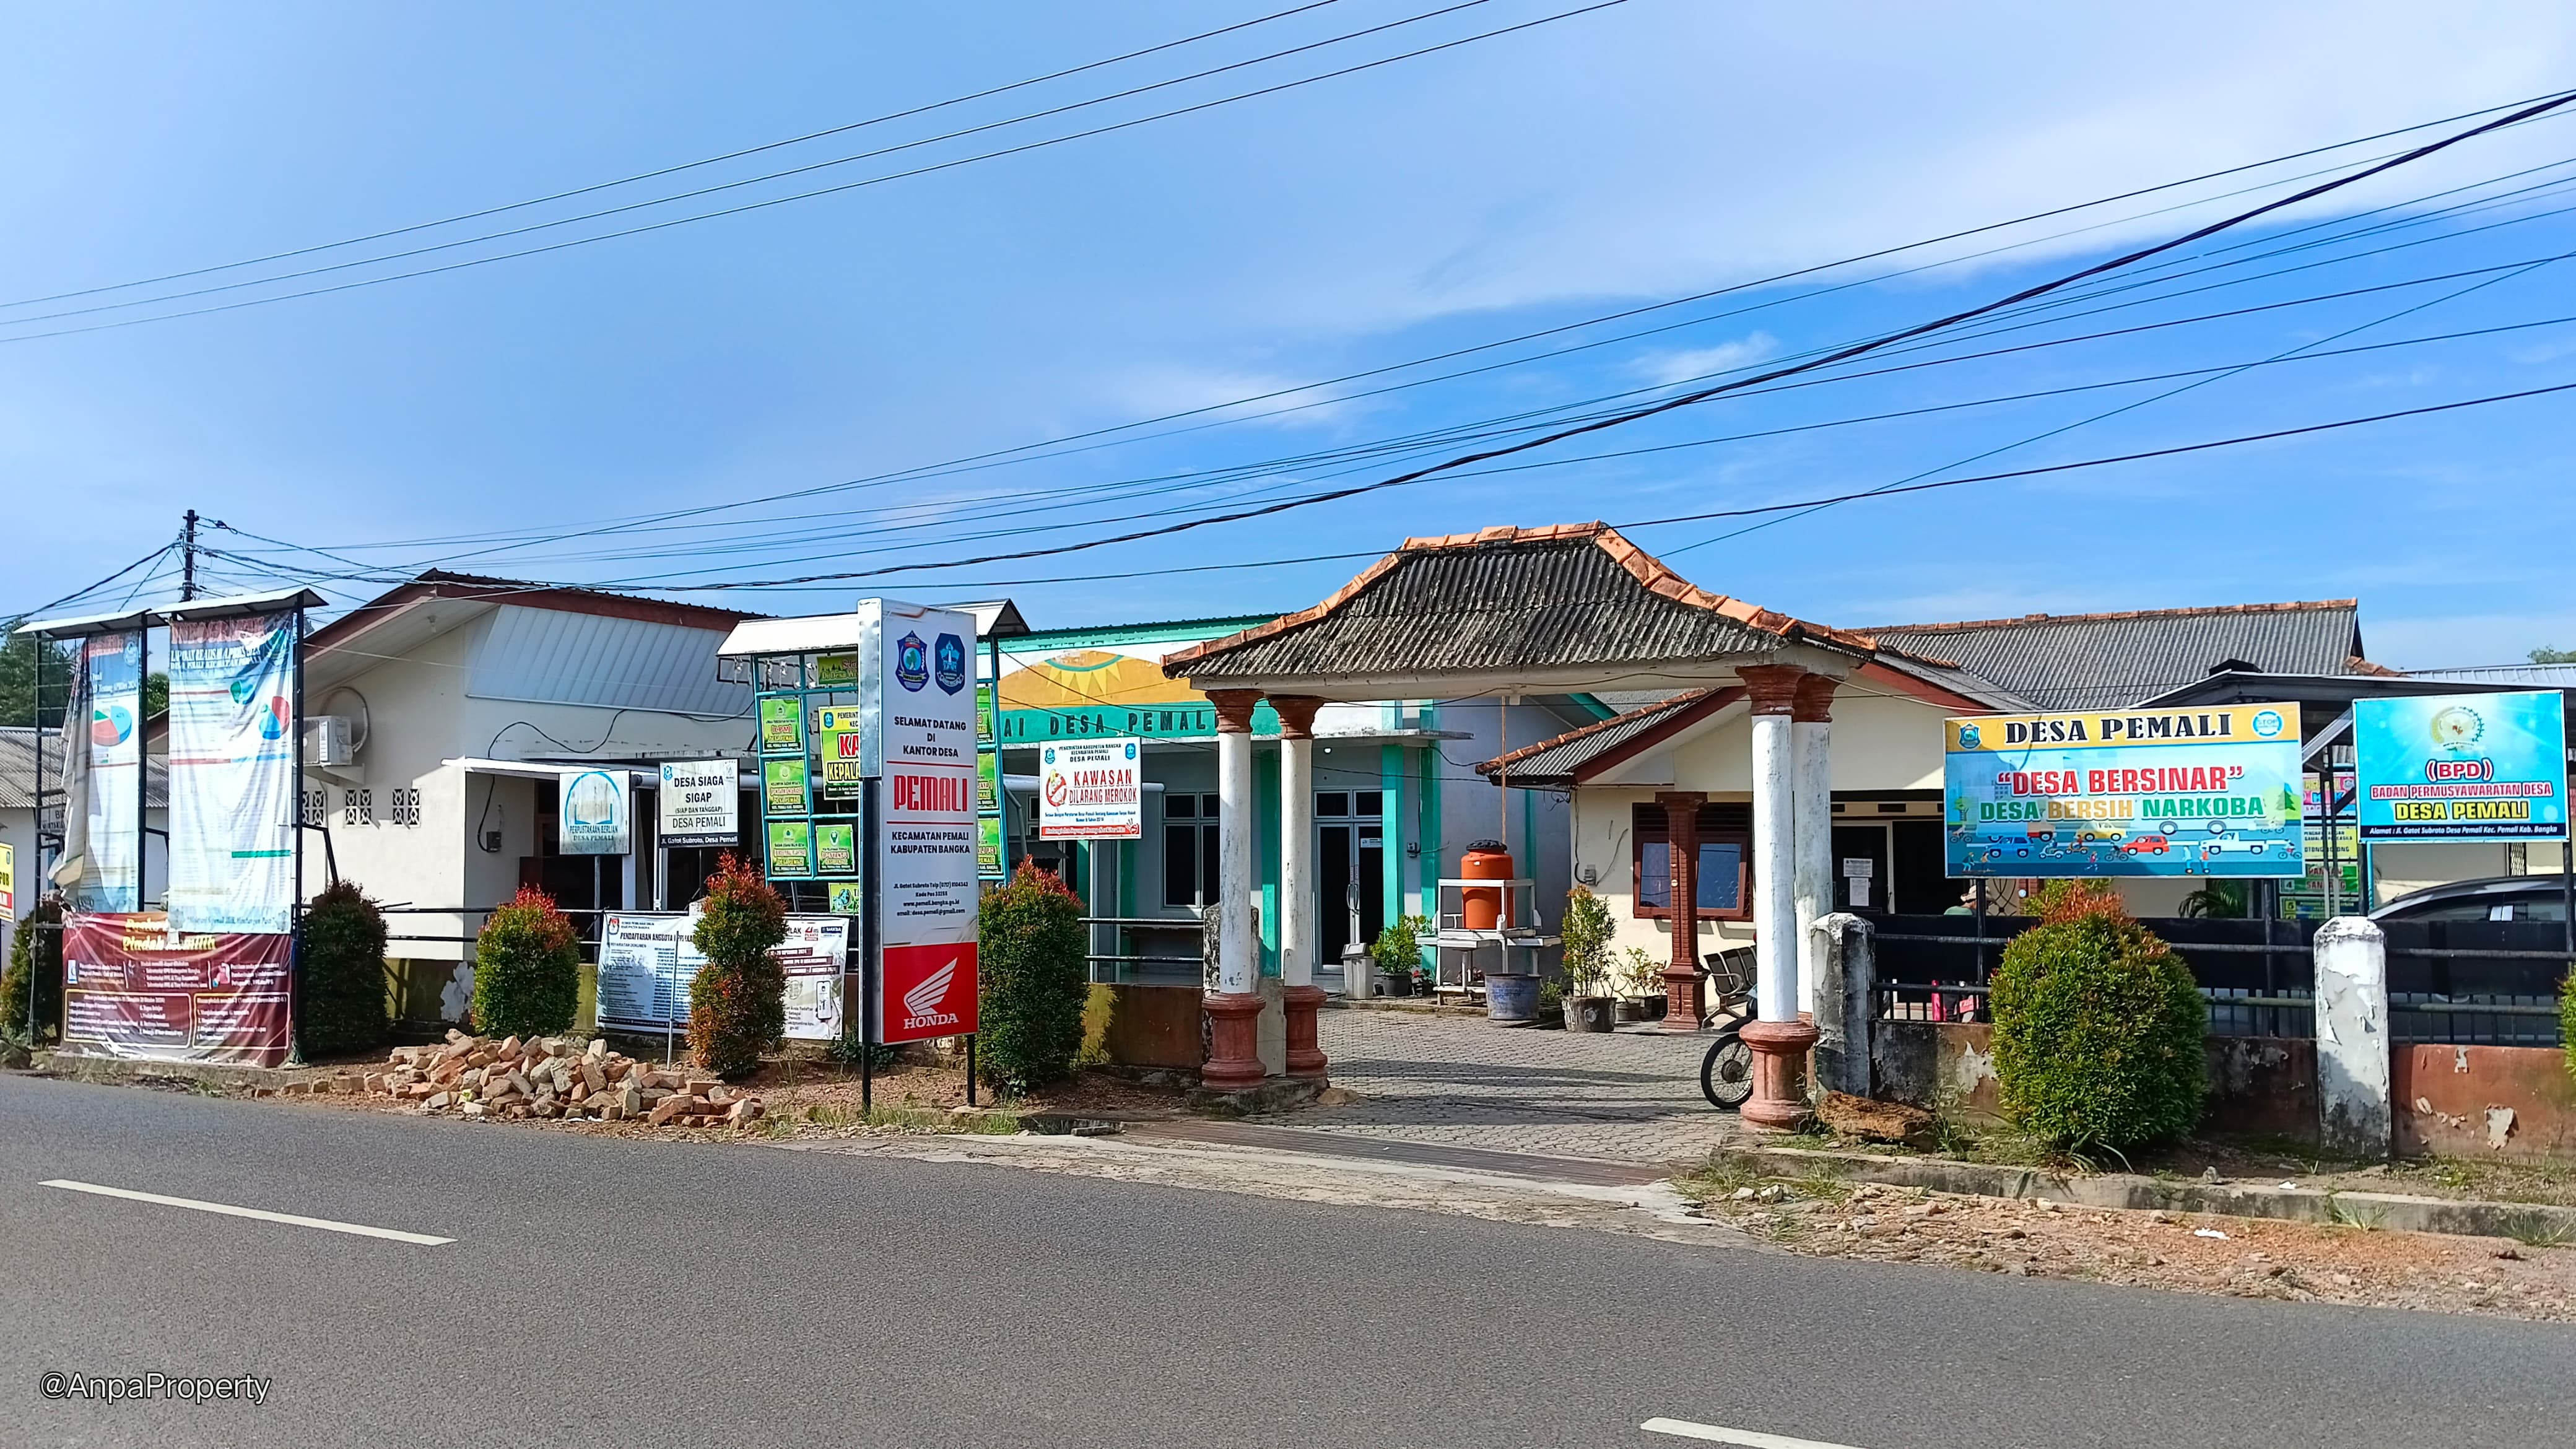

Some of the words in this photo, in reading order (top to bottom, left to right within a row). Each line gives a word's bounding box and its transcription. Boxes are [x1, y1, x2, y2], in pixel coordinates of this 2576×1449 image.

[894, 716, 932, 728] SELAMAT
[933, 720, 967, 731] DATANG
[1050, 713, 1105, 735] DESA
[2006, 720, 2089, 744] DESA
[2101, 714, 2232, 740] PEMALI
[927, 733, 936, 742] DI
[903, 745, 938, 757] KANTOR
[938, 747, 959, 757] DESA
[1074, 768, 1133, 786] KAWASAN
[2427, 760, 2493, 780] (BPD)
[674, 777, 696, 788] DESA
[698, 775, 724, 786] SIAGA
[685, 792, 712, 803] SIGAP
[894, 775, 968, 812] PEMALI
[1069, 789, 1103, 804] DILARANG
[1105, 787, 1138, 803] MEROKOK
[2371, 785, 2408, 799] BADAN
[2411, 784, 2521, 799] PERMUSYAWARATAN
[2524, 782, 2552, 797] DESA
[1980, 802, 2040, 820] DESA
[2047, 800, 2133, 819] BERSIH
[2142, 797, 2265, 817] NARKOBA
[2395, 803, 2447, 820] DESA
[2453, 801, 2529, 819] PEMALI
[672, 817, 694, 829] DESA
[695, 816, 726, 827] PEMALI
[2534, 825, 2557, 834] Bangka
[892, 831, 941, 840] KECAMATAN
[942, 832, 969, 840] PEMALI
[890, 845, 938, 854] KABUPATEN
[938, 845, 970, 854] BANGKA
[620, 932, 651, 941] PENDAFTARAN
[652, 933, 673, 941] ANGGOTA
[903, 1013, 960, 1029] HONDA
